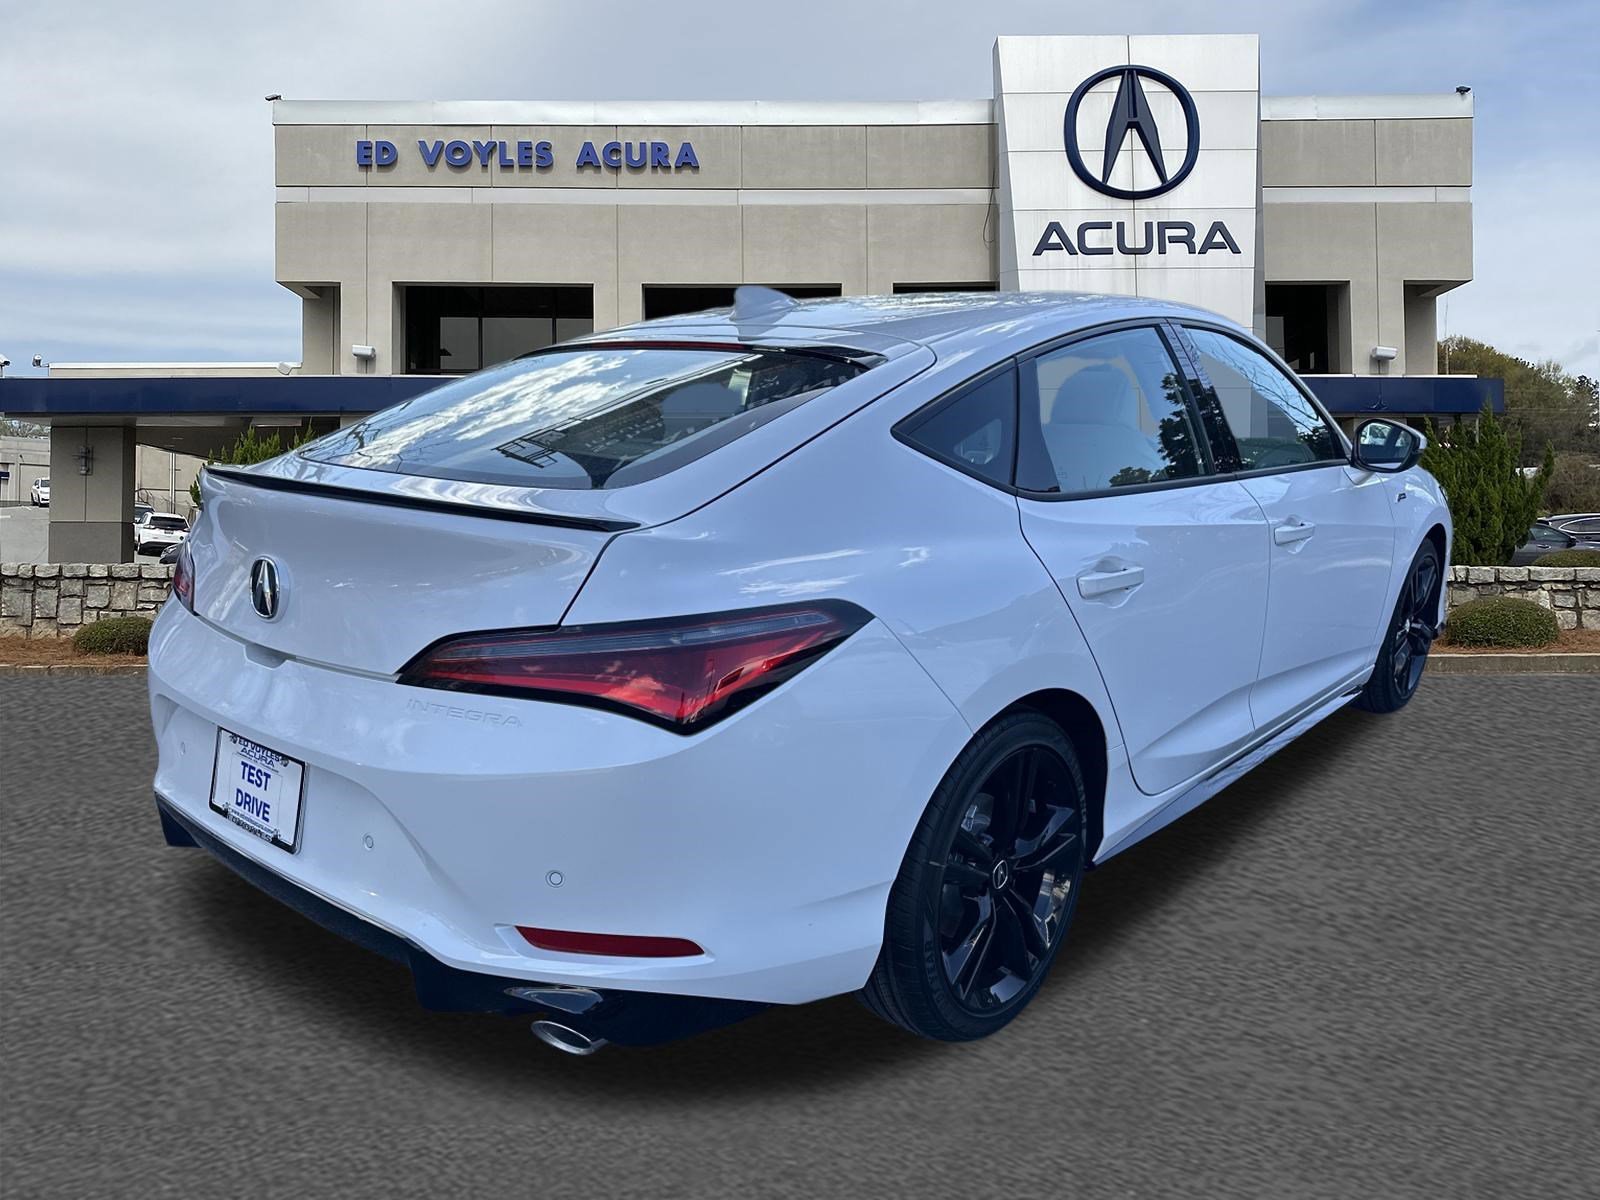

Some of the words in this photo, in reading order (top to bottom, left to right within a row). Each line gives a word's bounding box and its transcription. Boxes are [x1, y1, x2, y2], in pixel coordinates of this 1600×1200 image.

[356, 140, 398, 167] ED
[418, 140, 554, 168] VOYLES
[576, 141, 700, 168] ACURA
[1032, 221, 1242, 256] ACURA
[406, 698, 523, 728] INTEGRA
[240, 747, 275, 768] ACURA
[240, 760, 272, 792] TEST
[235, 787, 271, 823] DRIVE
